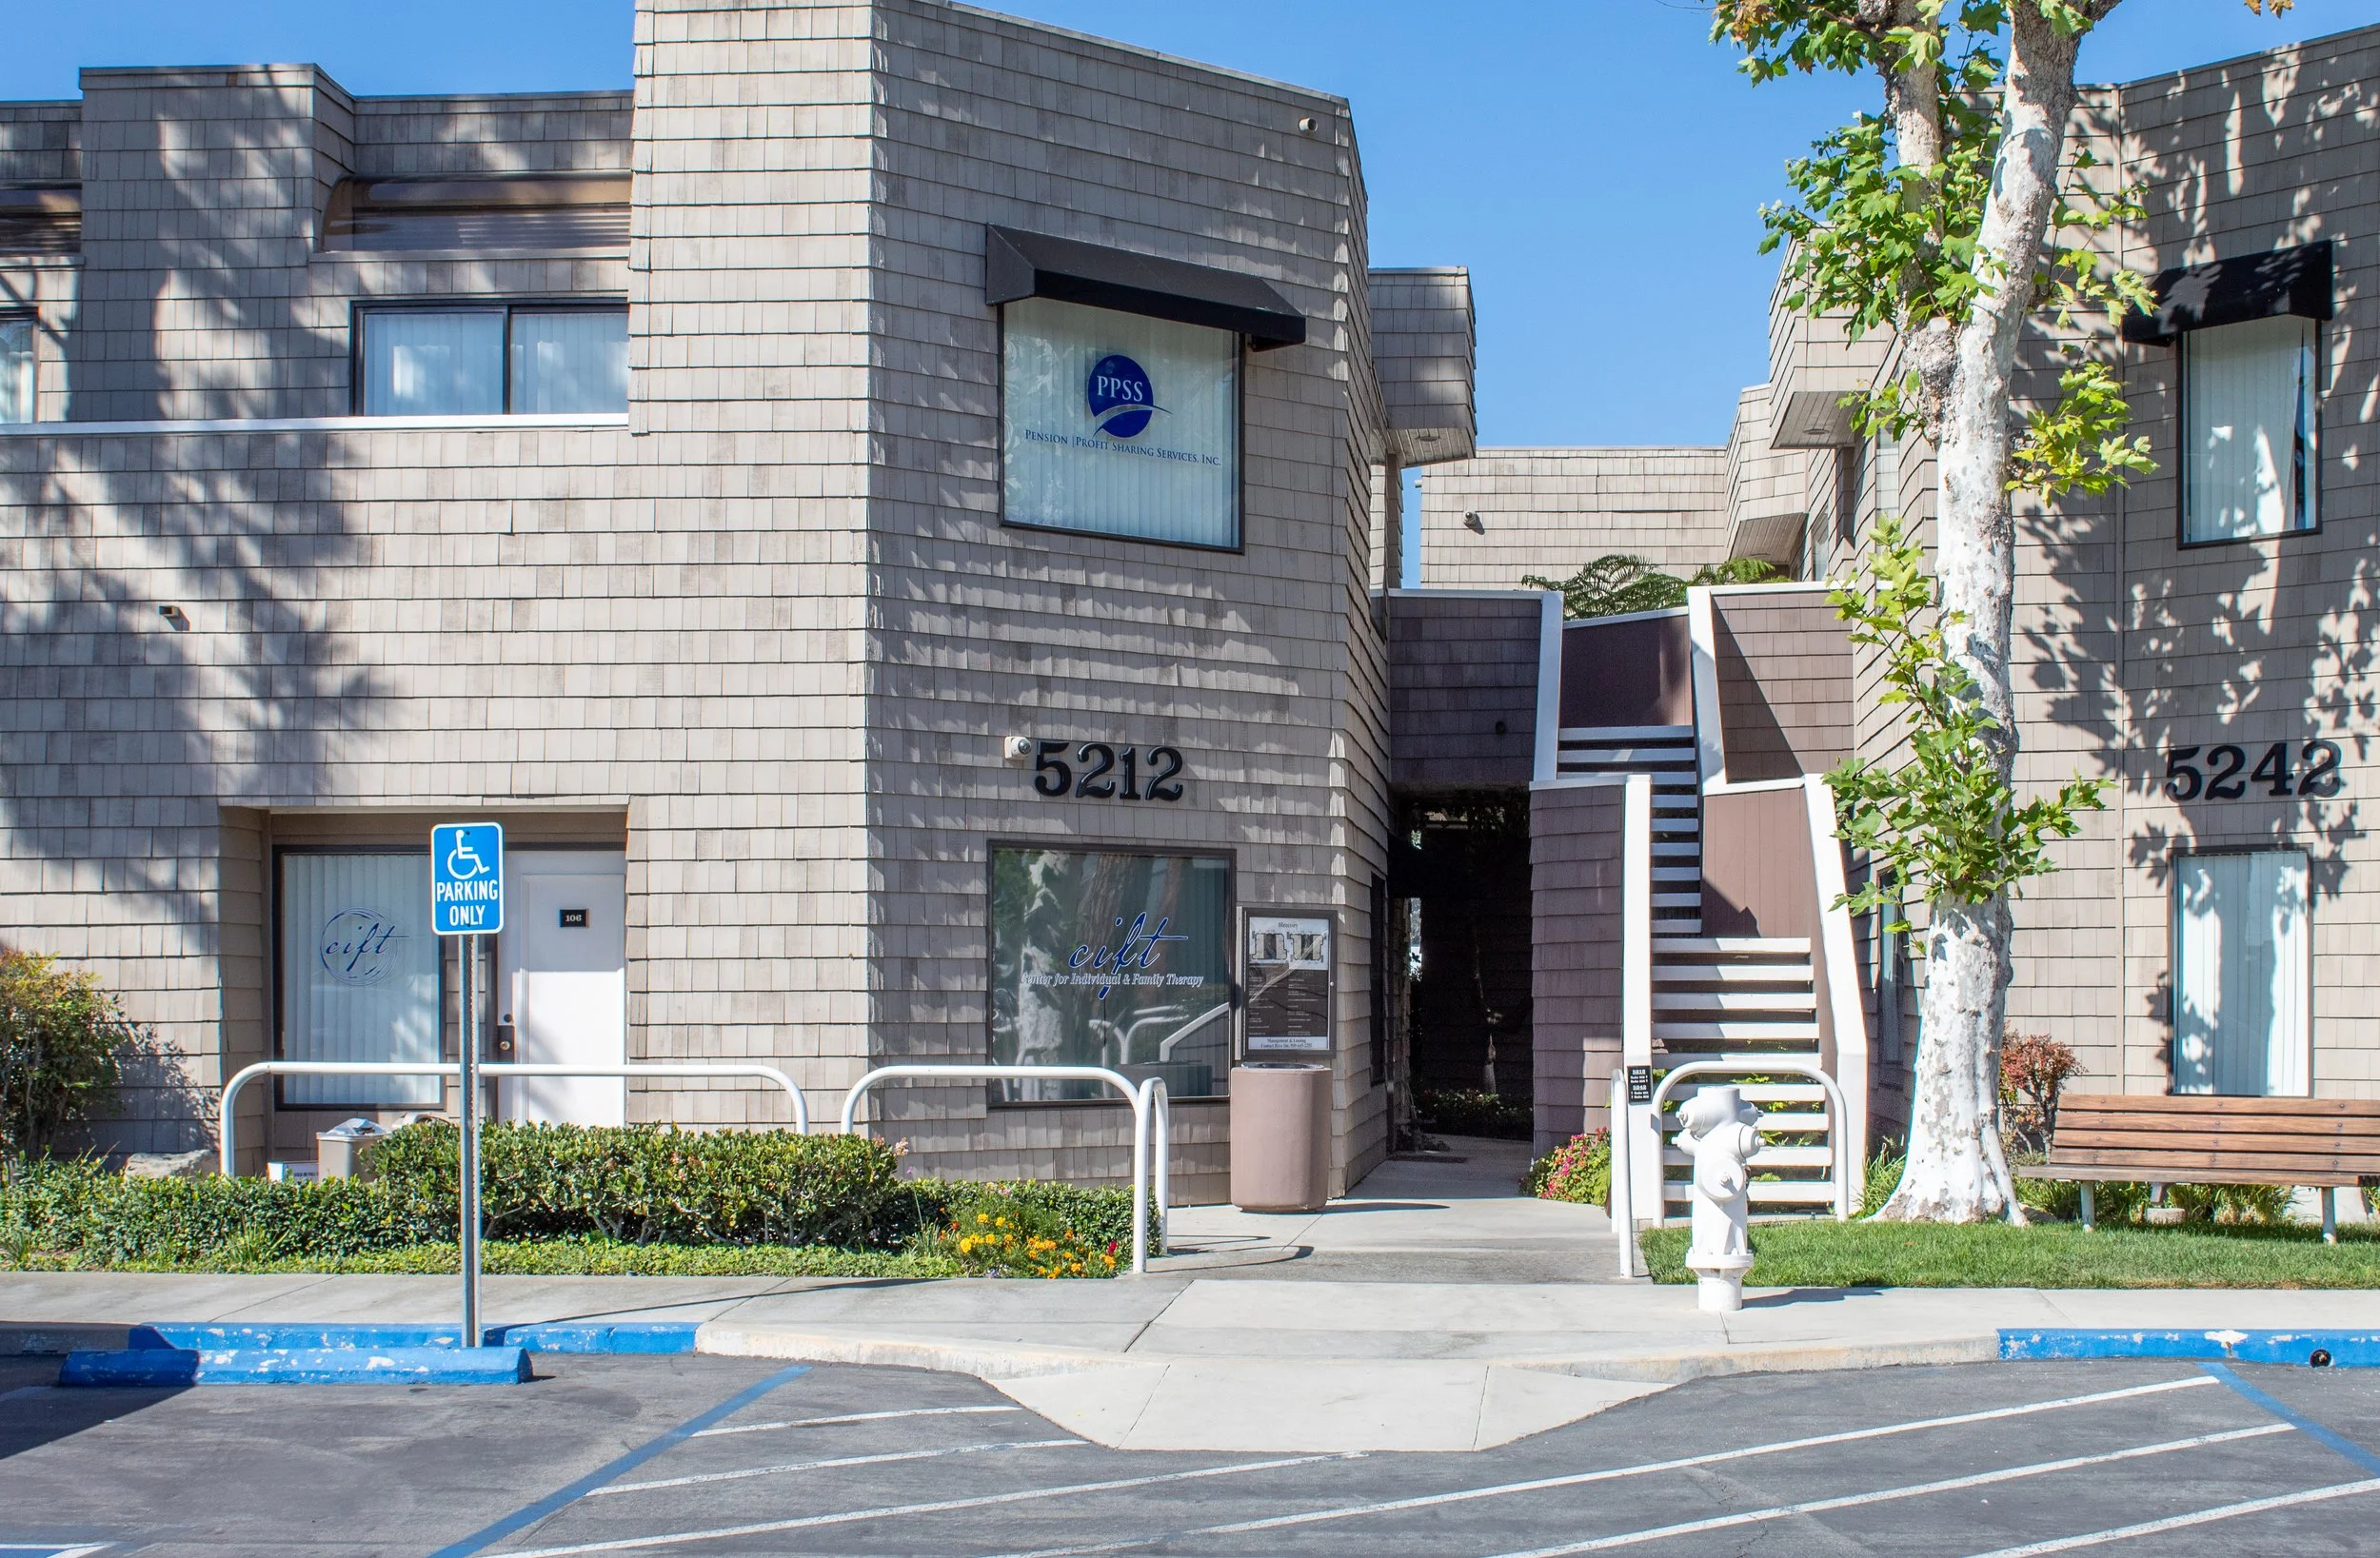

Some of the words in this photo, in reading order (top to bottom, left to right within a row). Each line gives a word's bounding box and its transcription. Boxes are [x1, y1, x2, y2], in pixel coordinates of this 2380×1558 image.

[1097, 375, 1143, 402] PPSS
[1034, 740, 1184, 801] 5212
[2165, 740, 2342, 803] 5242
[436, 879, 498, 902] PARKING
[449, 904, 486, 926] ONLY
[565, 914, 582, 922] 106
[326, 922, 410, 972] cift
[1068, 911, 1189, 999] cift
[1021, 973, 1052, 985] Center
[1052, 972, 1069, 987] for
[1071, 973, 1121, 985] Individual
[1122, 973, 1131, 985] &
[1132, 973, 1164, 988] Family
[1166, 974, 1204, 988] Therapy
